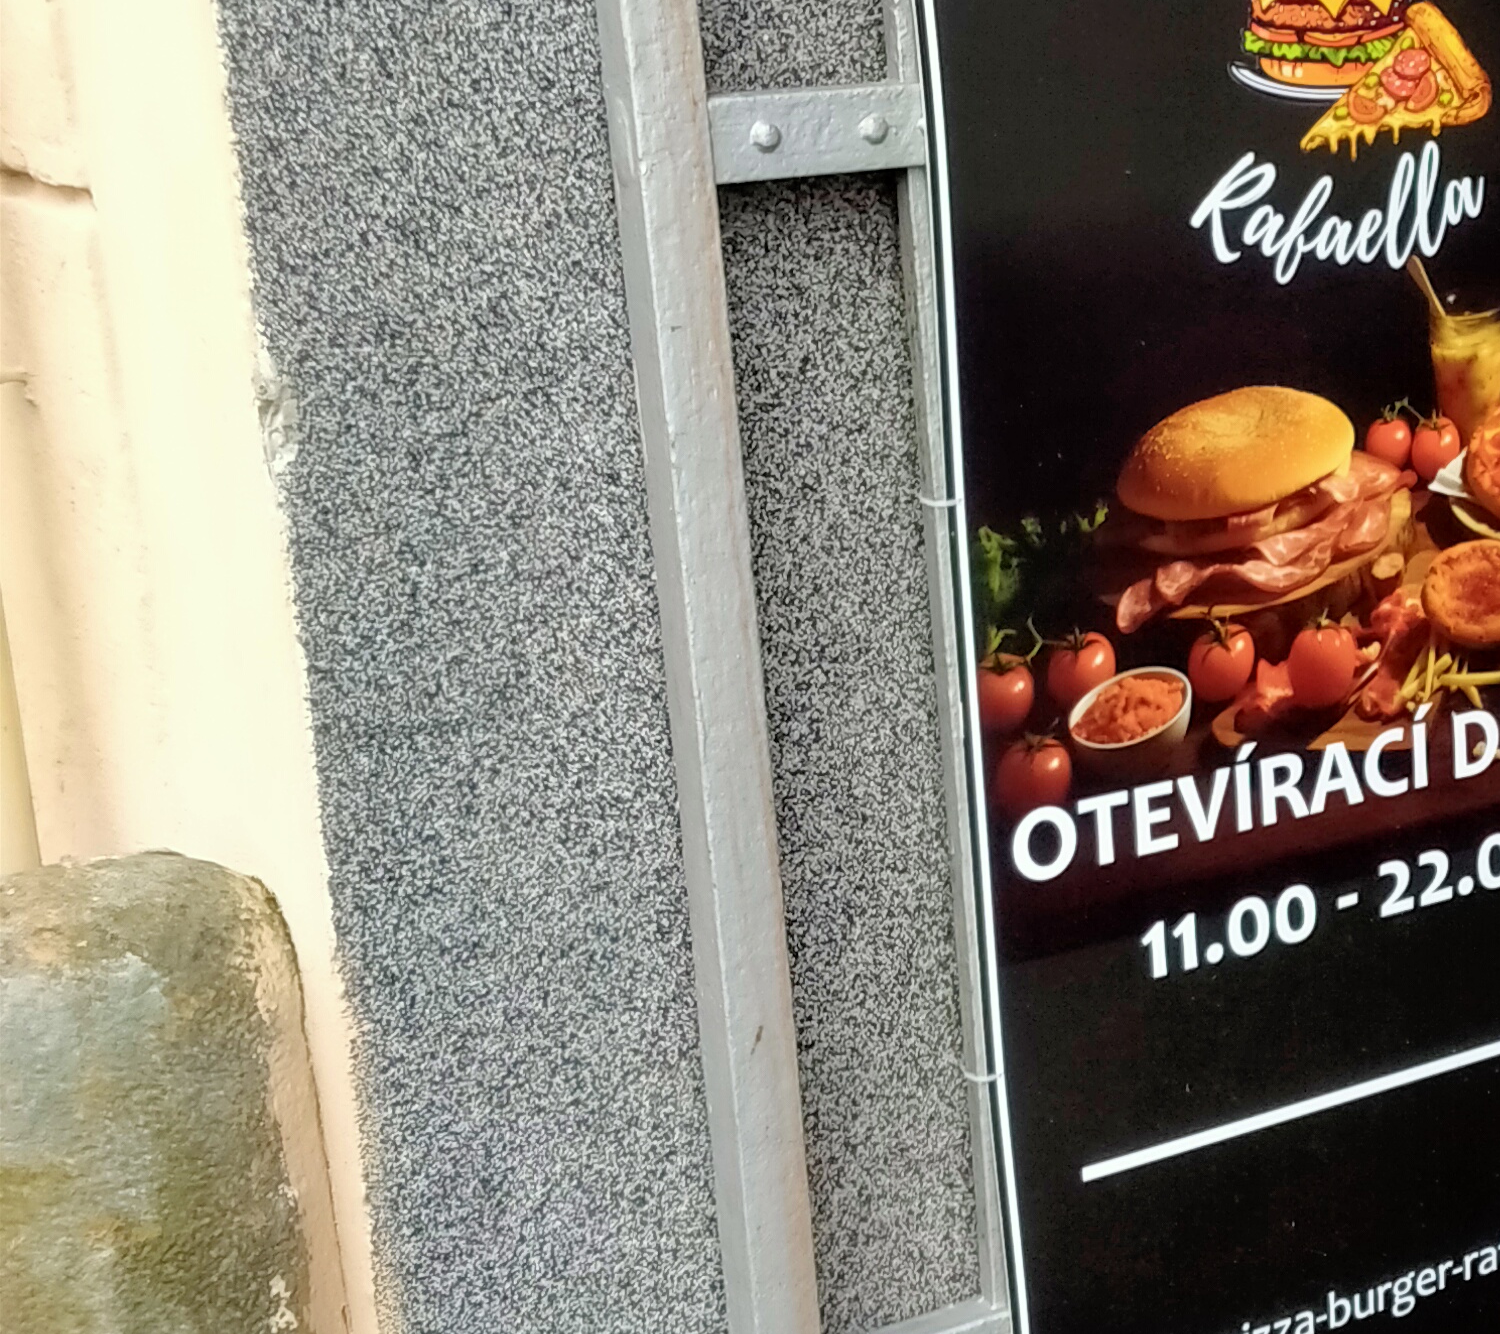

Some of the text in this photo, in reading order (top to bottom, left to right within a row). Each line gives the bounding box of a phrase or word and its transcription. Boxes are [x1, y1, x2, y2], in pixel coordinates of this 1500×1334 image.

[1189, 139, 1485, 285] Rafaella
[1011, 702, 1434, 884] OTEVÍRACÍ
[1140, 883, 1318, 979] 11.00
[1336, 890, 1360, 911] -
